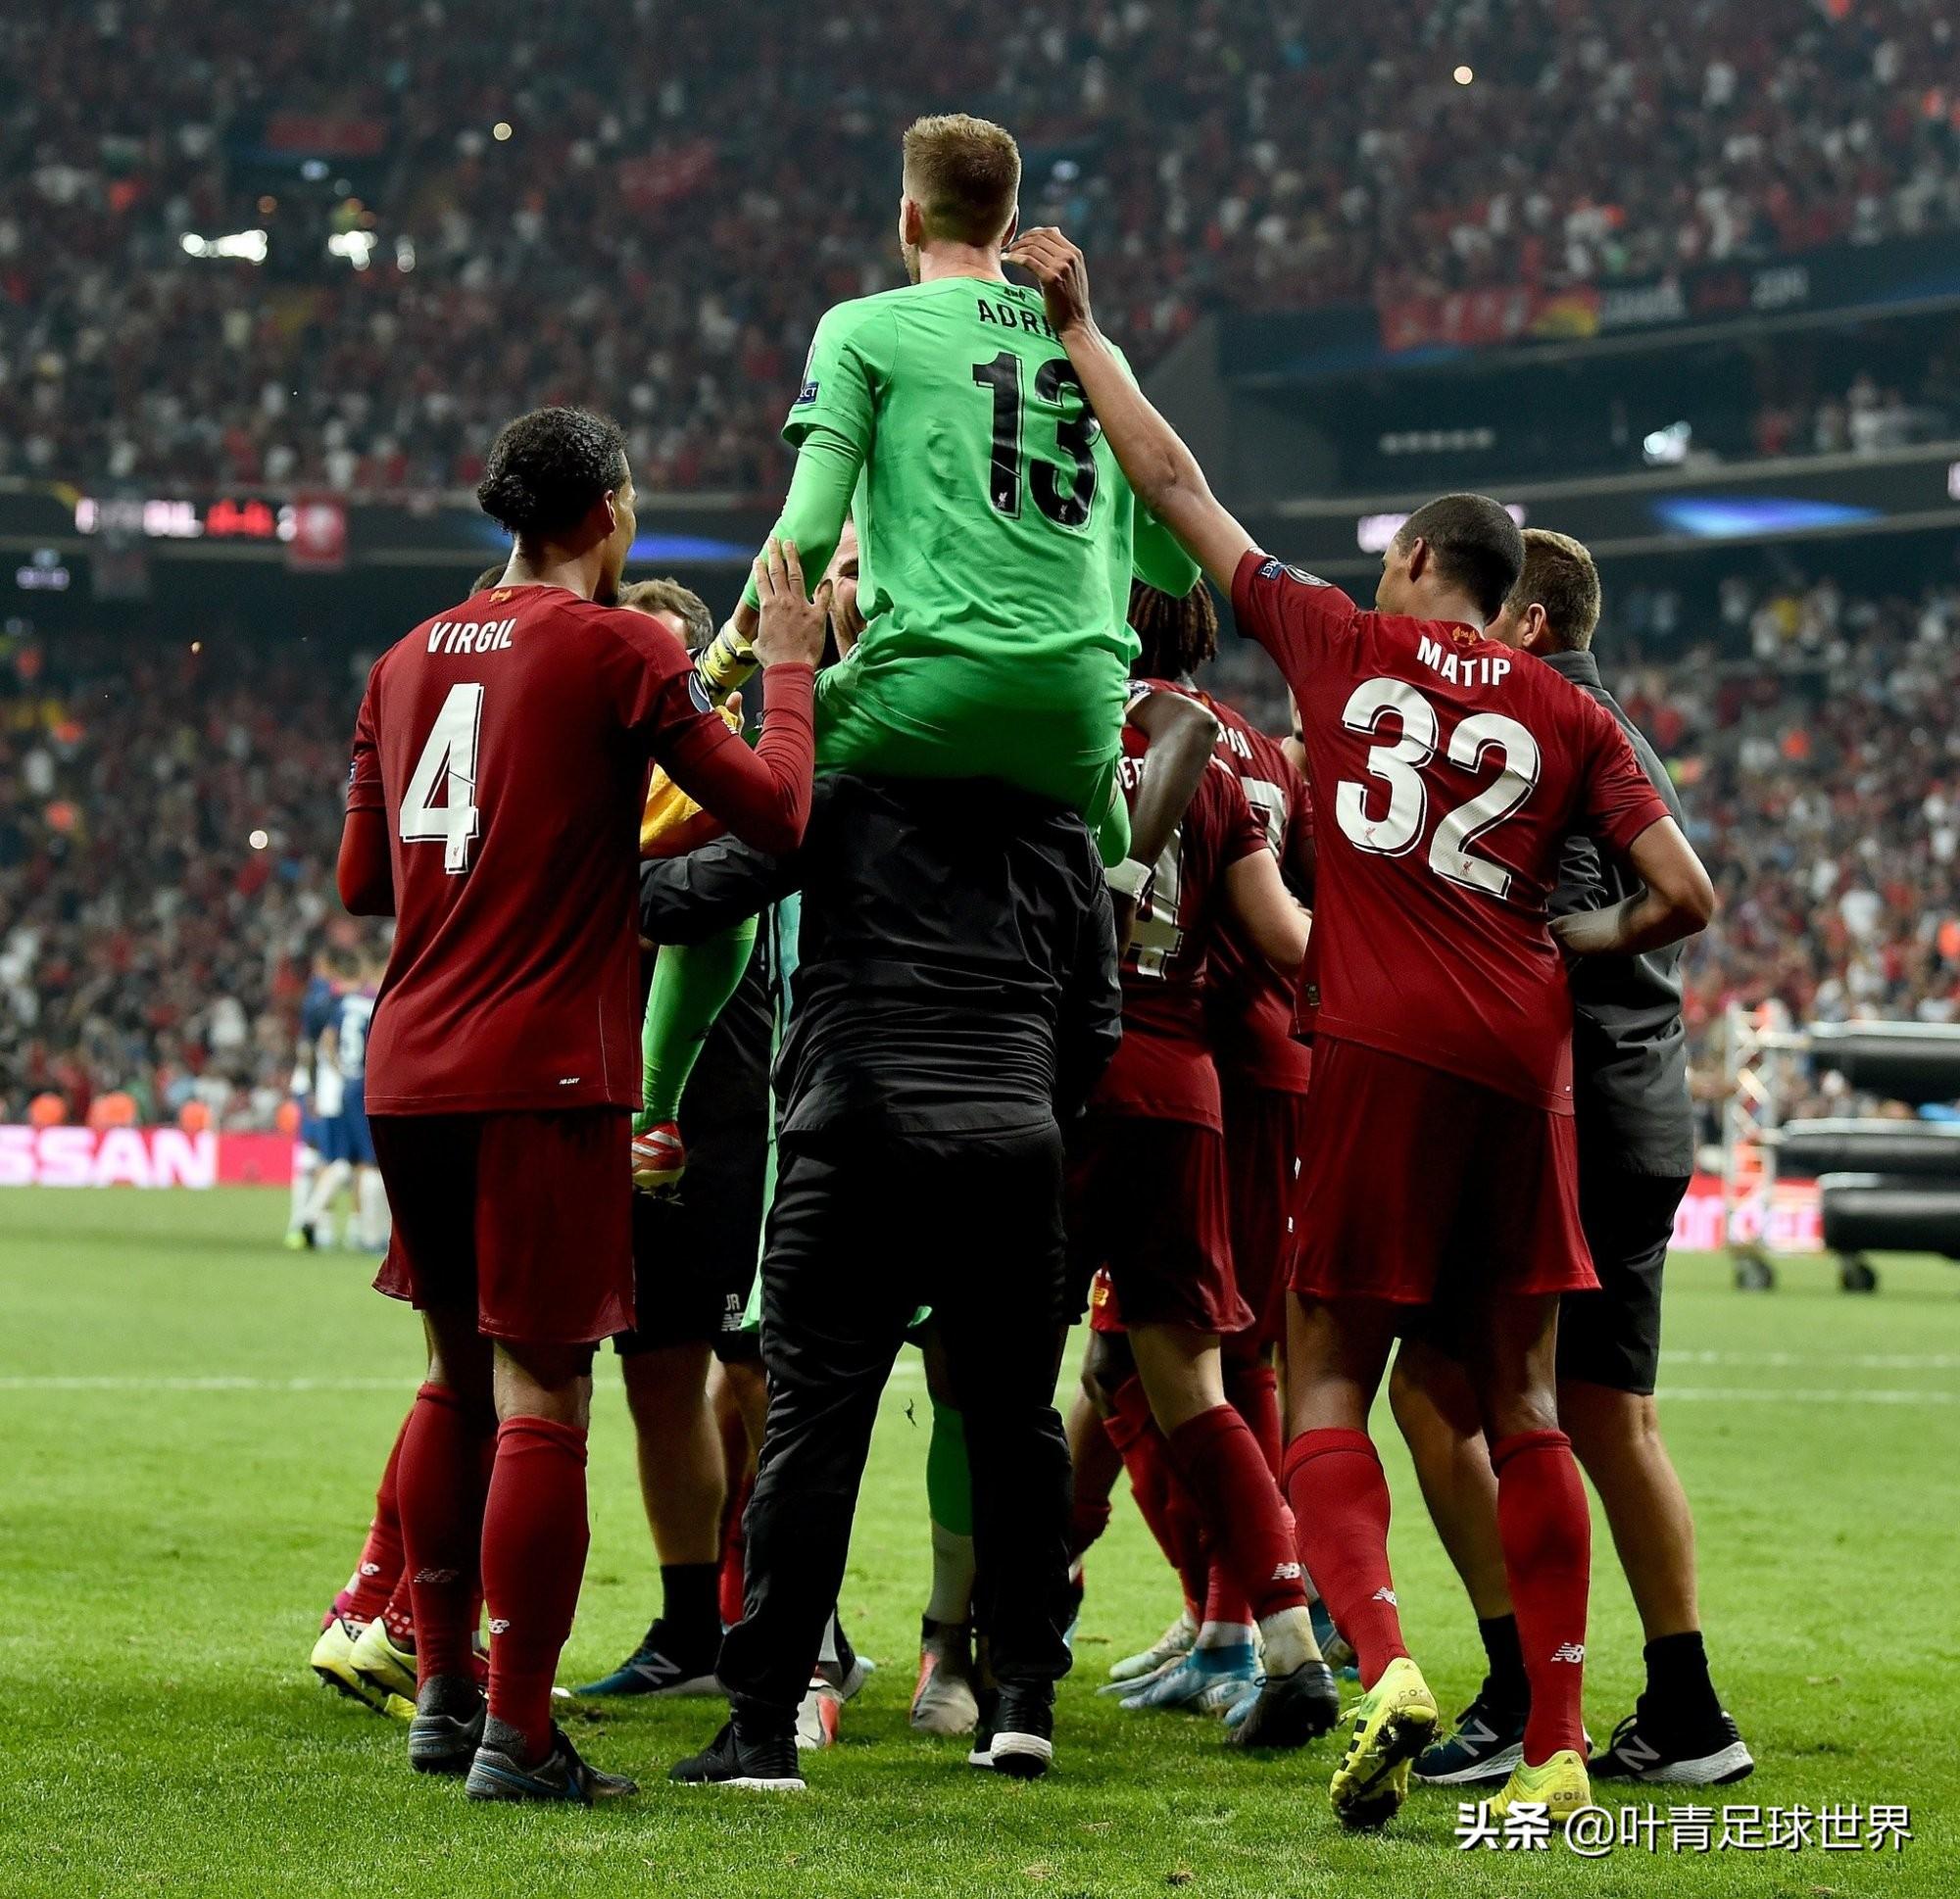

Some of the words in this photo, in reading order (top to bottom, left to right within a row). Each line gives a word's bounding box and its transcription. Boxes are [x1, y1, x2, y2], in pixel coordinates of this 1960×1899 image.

[977, 299, 1062, 343] ADRI
[972, 352, 1102, 532] 13
[426, 618, 516, 654] VIRGIL
[1417, 635, 1511, 686] MATIP
[399, 682, 484, 874] 4
[1336, 677, 1541, 900] 32
